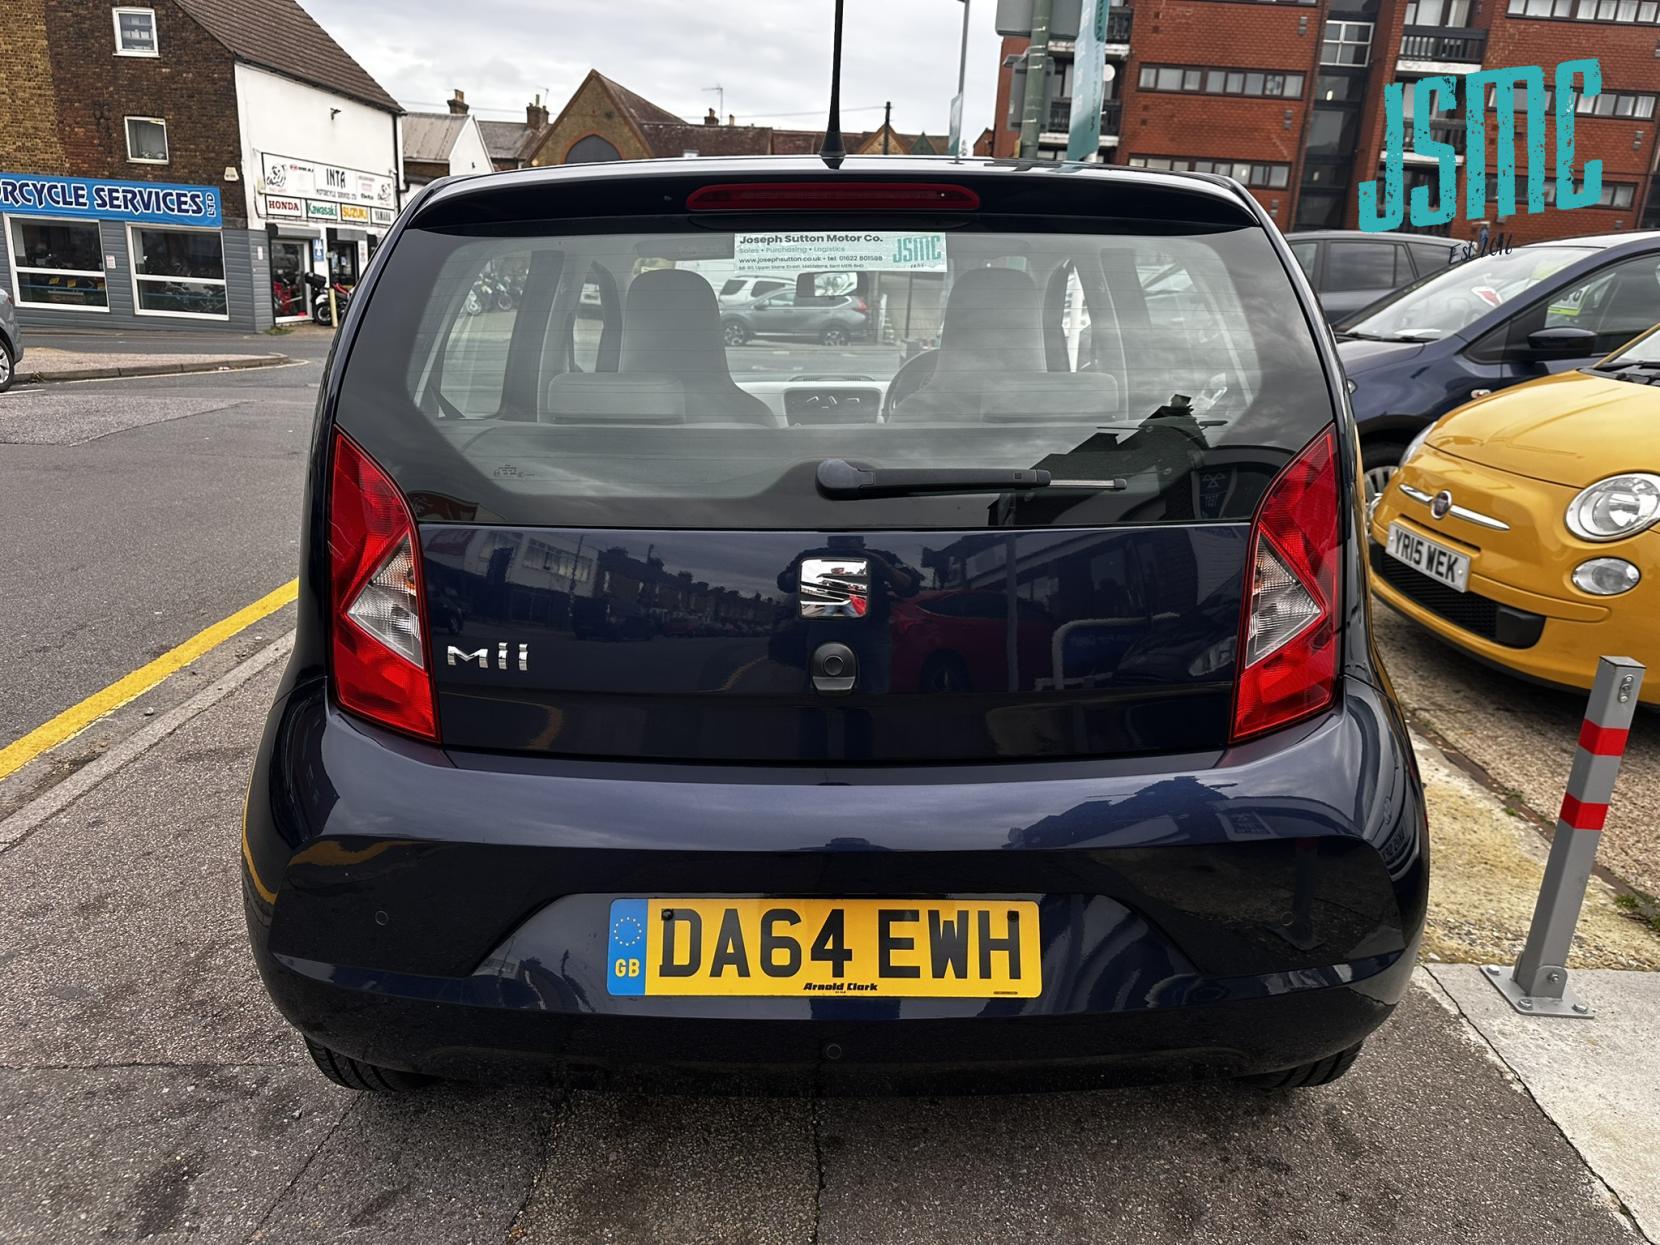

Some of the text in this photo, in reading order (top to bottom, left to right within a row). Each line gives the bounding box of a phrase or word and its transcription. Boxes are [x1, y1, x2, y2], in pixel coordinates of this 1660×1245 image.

[325, 167, 346, 189] INTA
[0, 179, 205, 216] RCYCLE SERVICES
[206, 192, 216, 217] LTD
[268, 200, 300, 211] HONDA
[307, 202, 338, 217] Kawasaki
[342, 206, 368, 220] SUZUKI
[740, 234, 884, 246] Joseph Sutton Motor Co.
[893, 235, 941, 262] JSMC
[739, 256, 821, 264] www.josephsutton.co.uk
[1395, 529, 1459, 583] YR15 WEK
[658, 908, 1022, 980] DA64 EWH
[615, 957, 640, 977] GB
[803, 982, 878, 991] Arnold Clark
